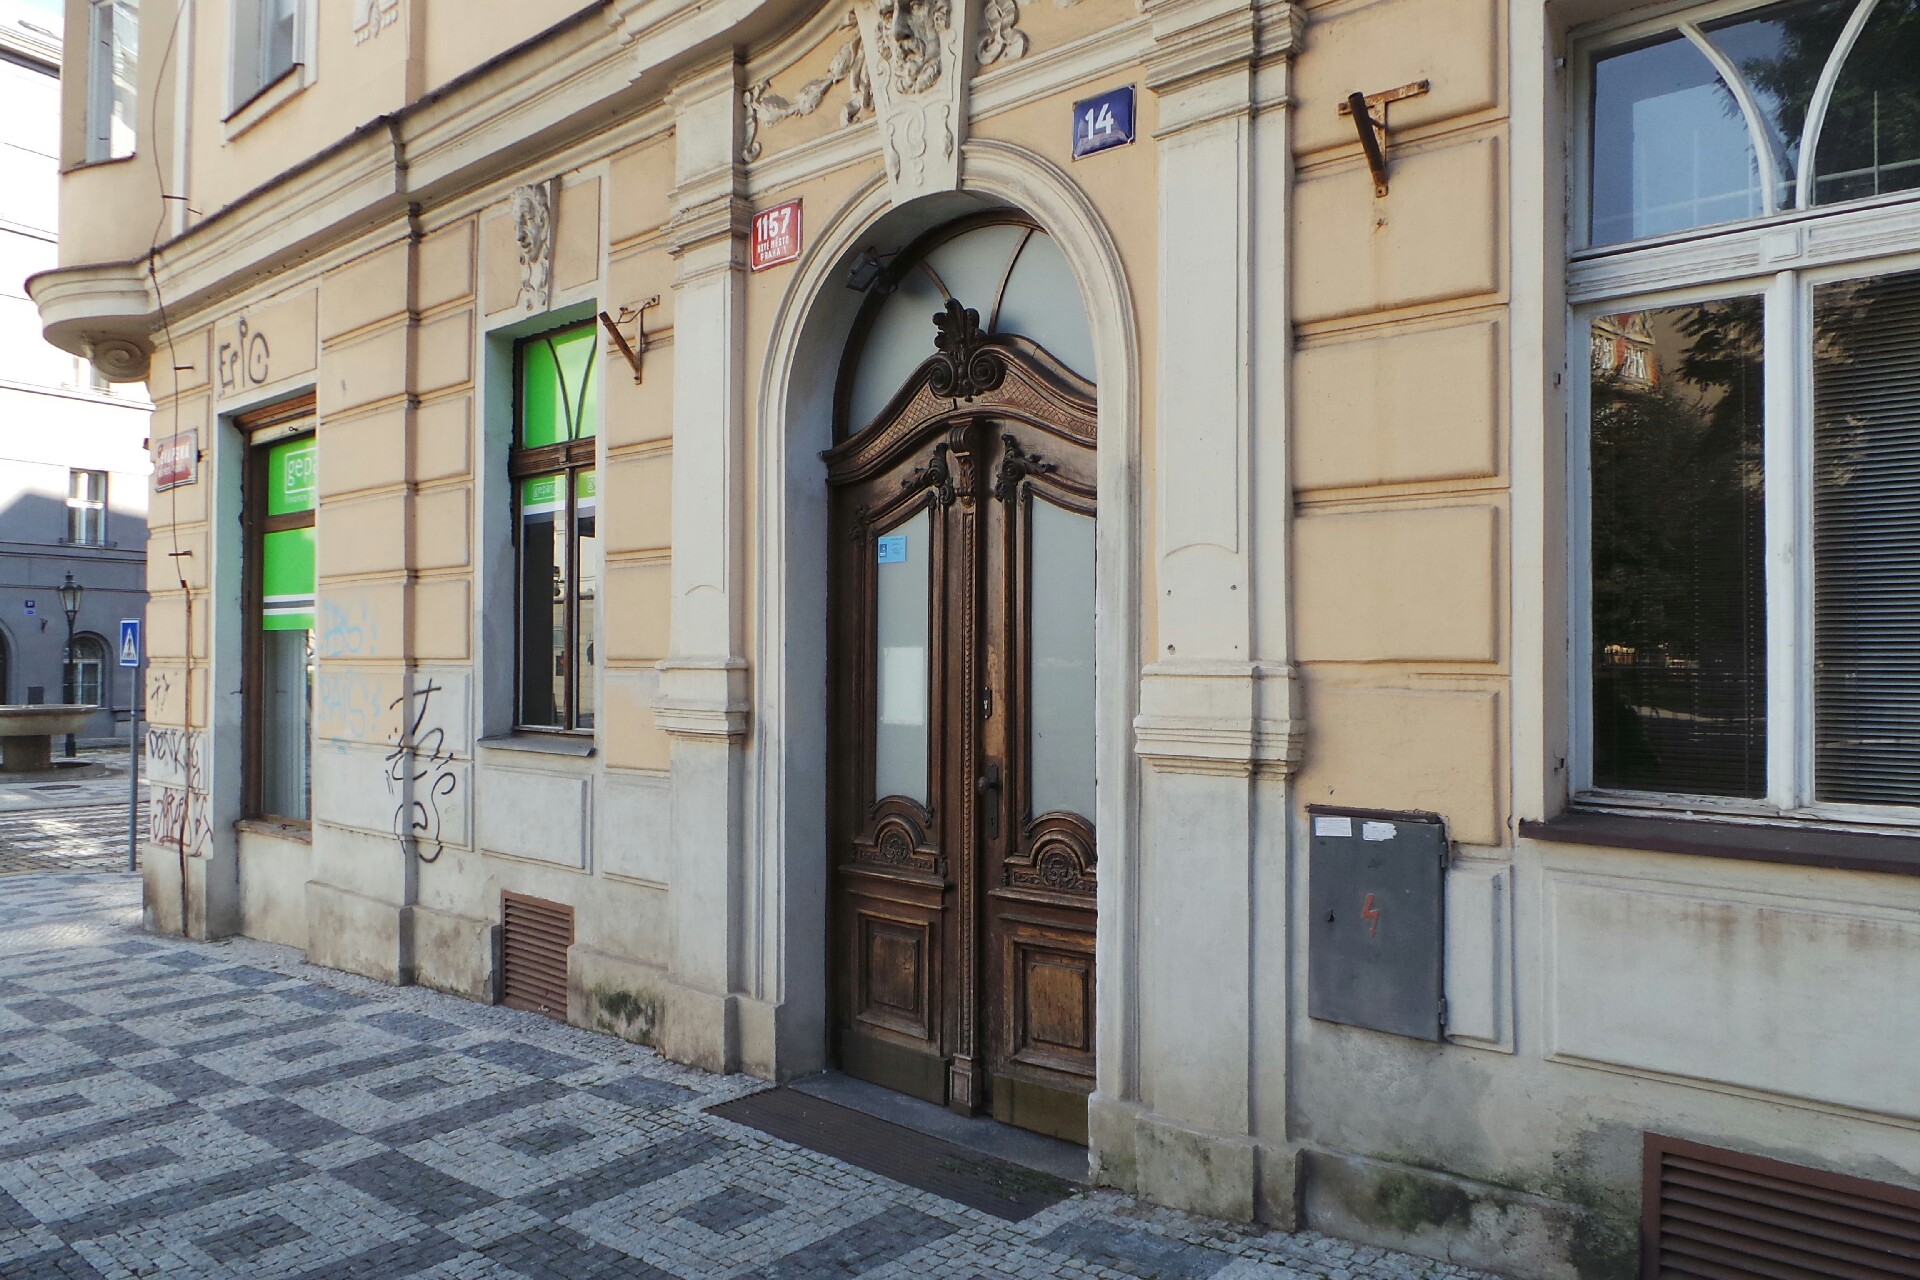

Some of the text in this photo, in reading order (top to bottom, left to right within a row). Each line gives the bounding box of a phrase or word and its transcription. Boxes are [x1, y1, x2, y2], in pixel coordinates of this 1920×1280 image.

[1085, 103, 1114, 140] 14
[757, 207, 791, 242] 1157
[760, 247, 780, 261] PRAHA
